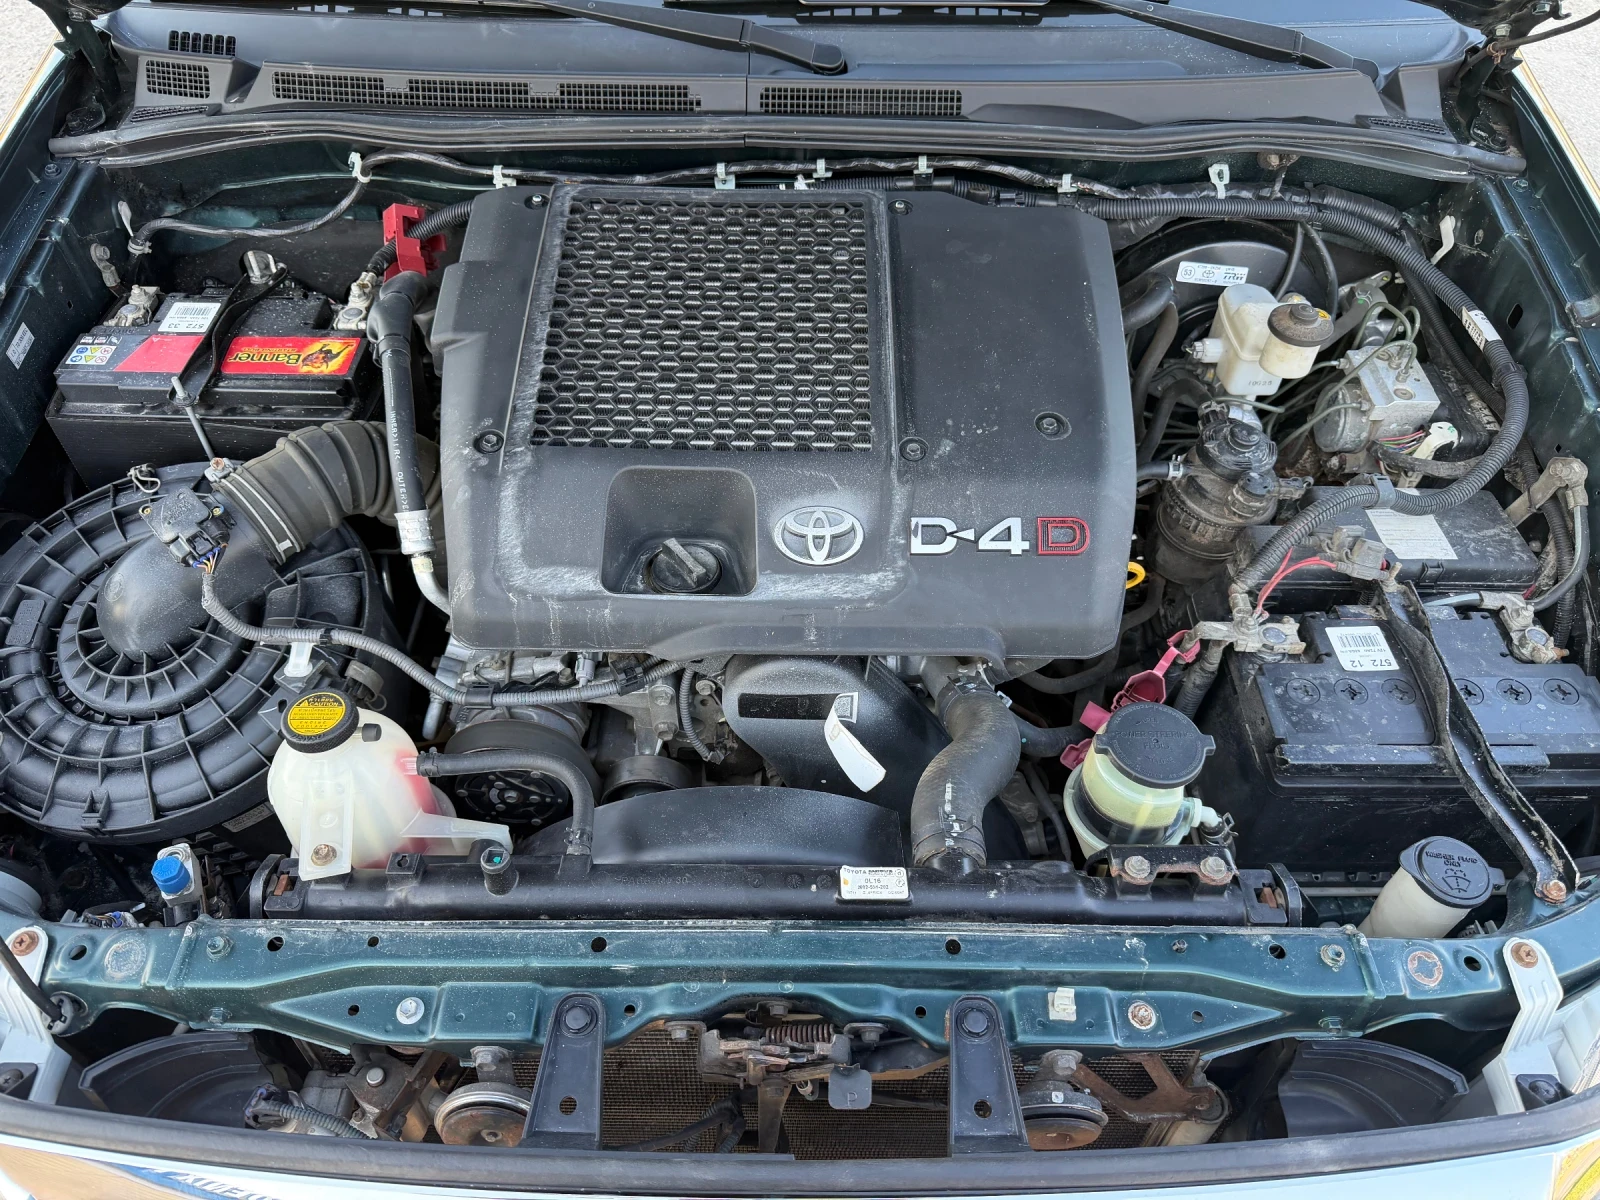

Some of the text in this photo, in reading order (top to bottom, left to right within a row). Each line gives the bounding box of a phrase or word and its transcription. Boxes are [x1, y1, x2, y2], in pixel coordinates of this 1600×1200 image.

[229, 351, 303, 366] Banner
[1349, 658, 1392, 668] 572 12
[1115, 730, 1195, 739] POWER STEERING
[1425, 850, 1479, 864] WASHER FLUID
[1443, 859, 1462, 868] ONLY
[843, 867, 867, 875] TOYOTA
